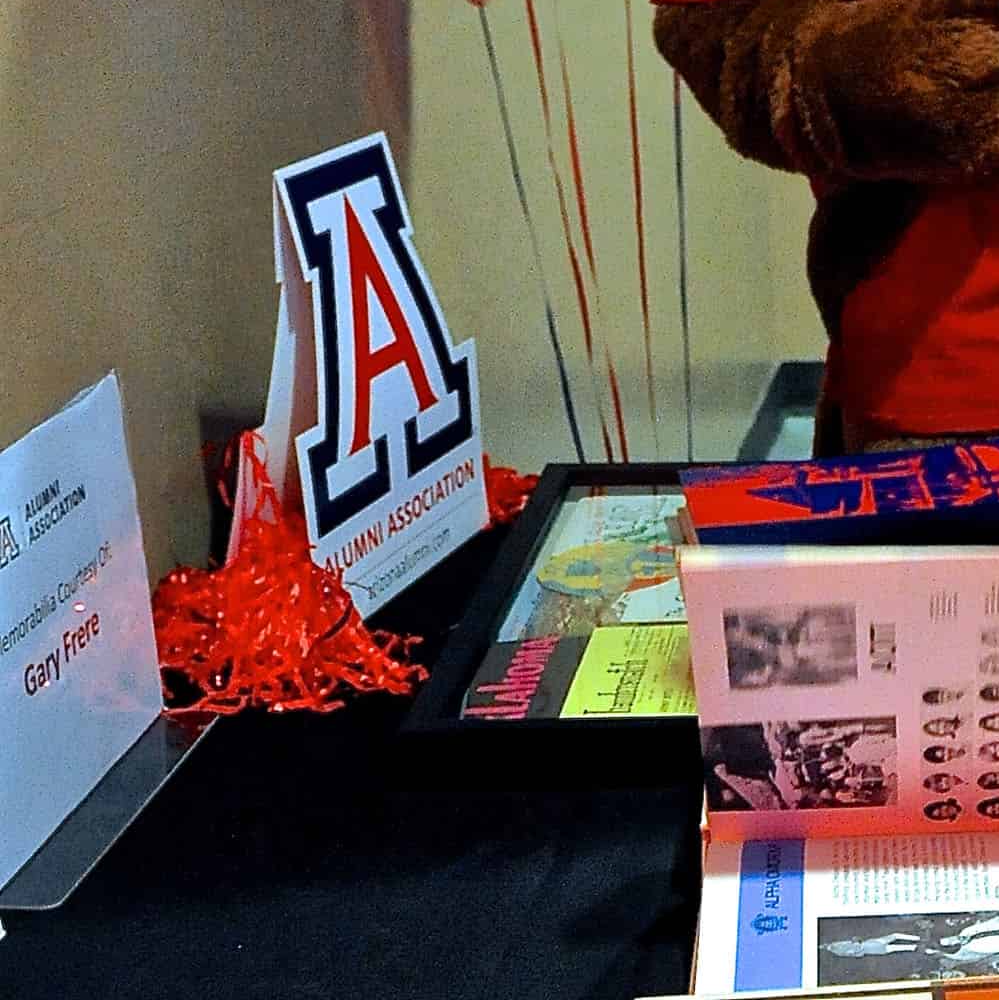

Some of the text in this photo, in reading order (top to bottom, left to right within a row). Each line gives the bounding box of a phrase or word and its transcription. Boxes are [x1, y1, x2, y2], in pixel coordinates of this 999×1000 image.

[283, 141, 473, 541] A
[25, 479, 60, 523] ALUMNI
[29, 484, 87, 545] ASSOCIATION
[325, 457, 475, 574] ALUMNI ASSOCIATION
[58, 556, 97, 604] Courtesy
[24, 612, 100, 697] Gary Frere
